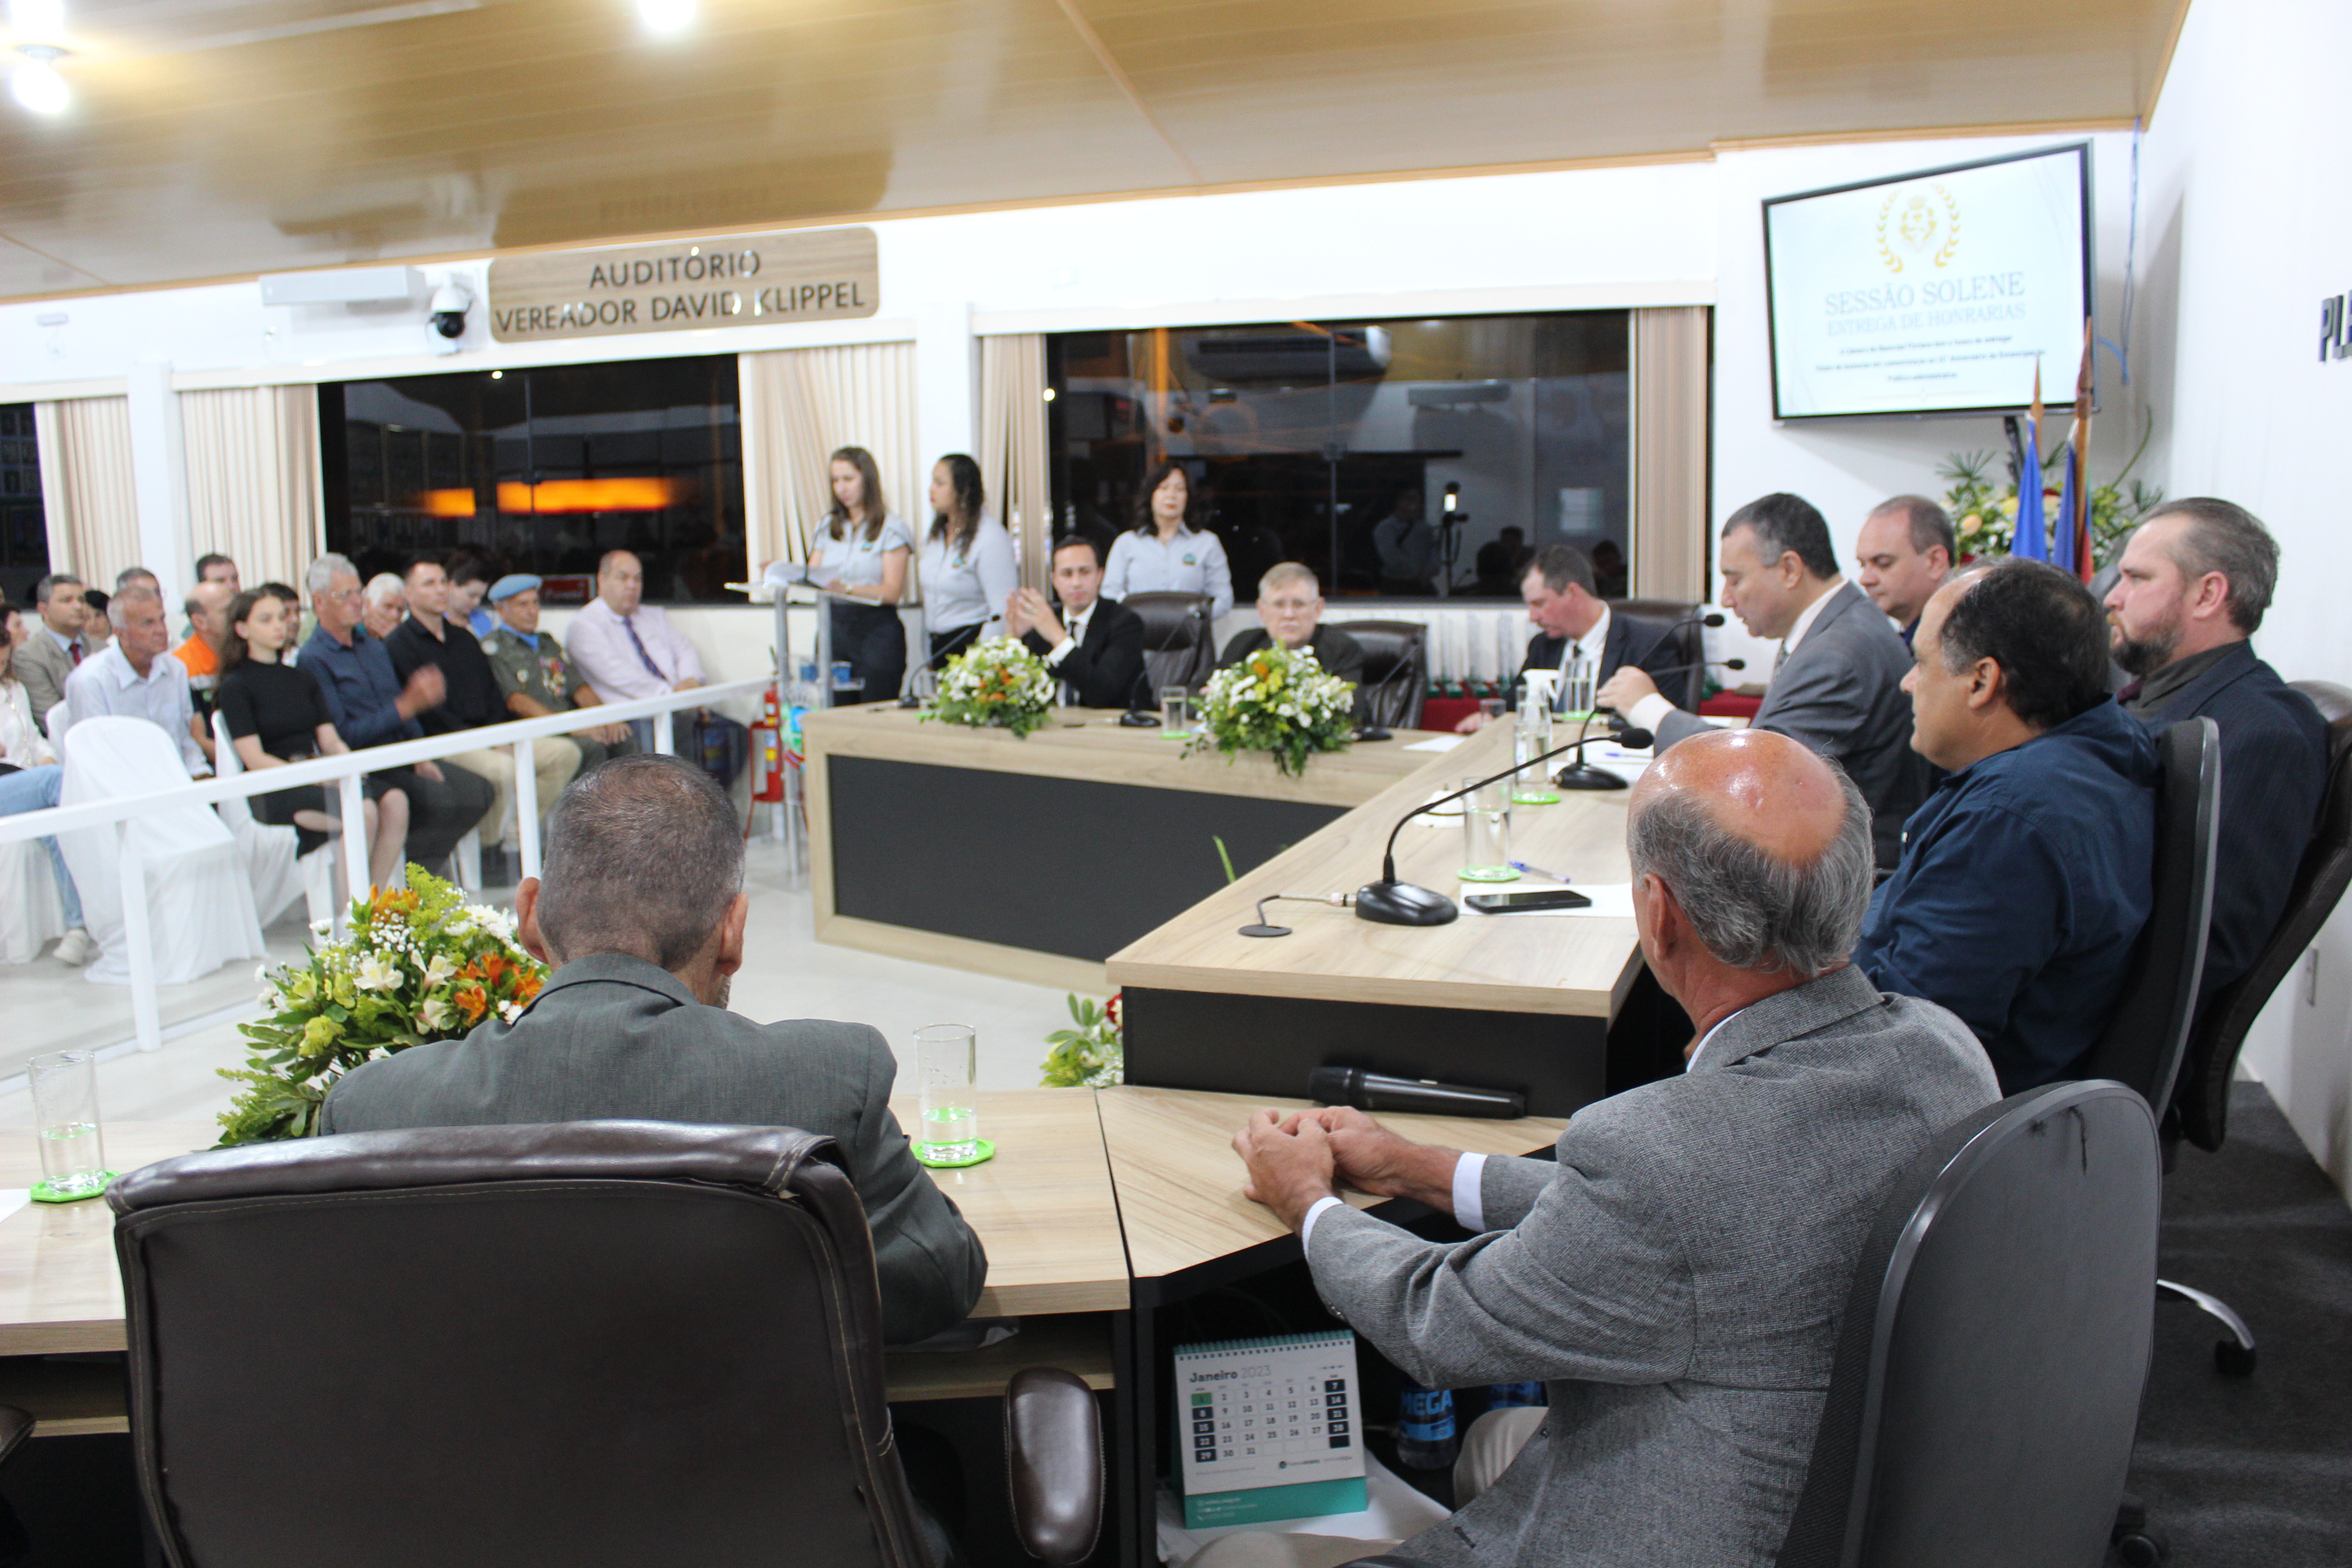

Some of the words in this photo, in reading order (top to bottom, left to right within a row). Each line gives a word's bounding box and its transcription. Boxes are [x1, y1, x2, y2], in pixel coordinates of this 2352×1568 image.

[590, 246, 760, 288] AUDITÓRIO
[495, 299, 637, 332] VEREADOR
[652, 291, 742, 321] DAVID
[754, 281, 865, 317] KLIPPEL
[1825, 282, 1914, 314] SESSÃO
[1923, 271, 2026, 305] SOLENE
[1828, 315, 1897, 336] ENTREGA
[1901, 311, 1924, 329] DE
[1929, 301, 2026, 327] HONRARIAS
[1190, 1369, 1238, 1382] Janeiro
[1241, 1365, 1270, 1379] 2023
